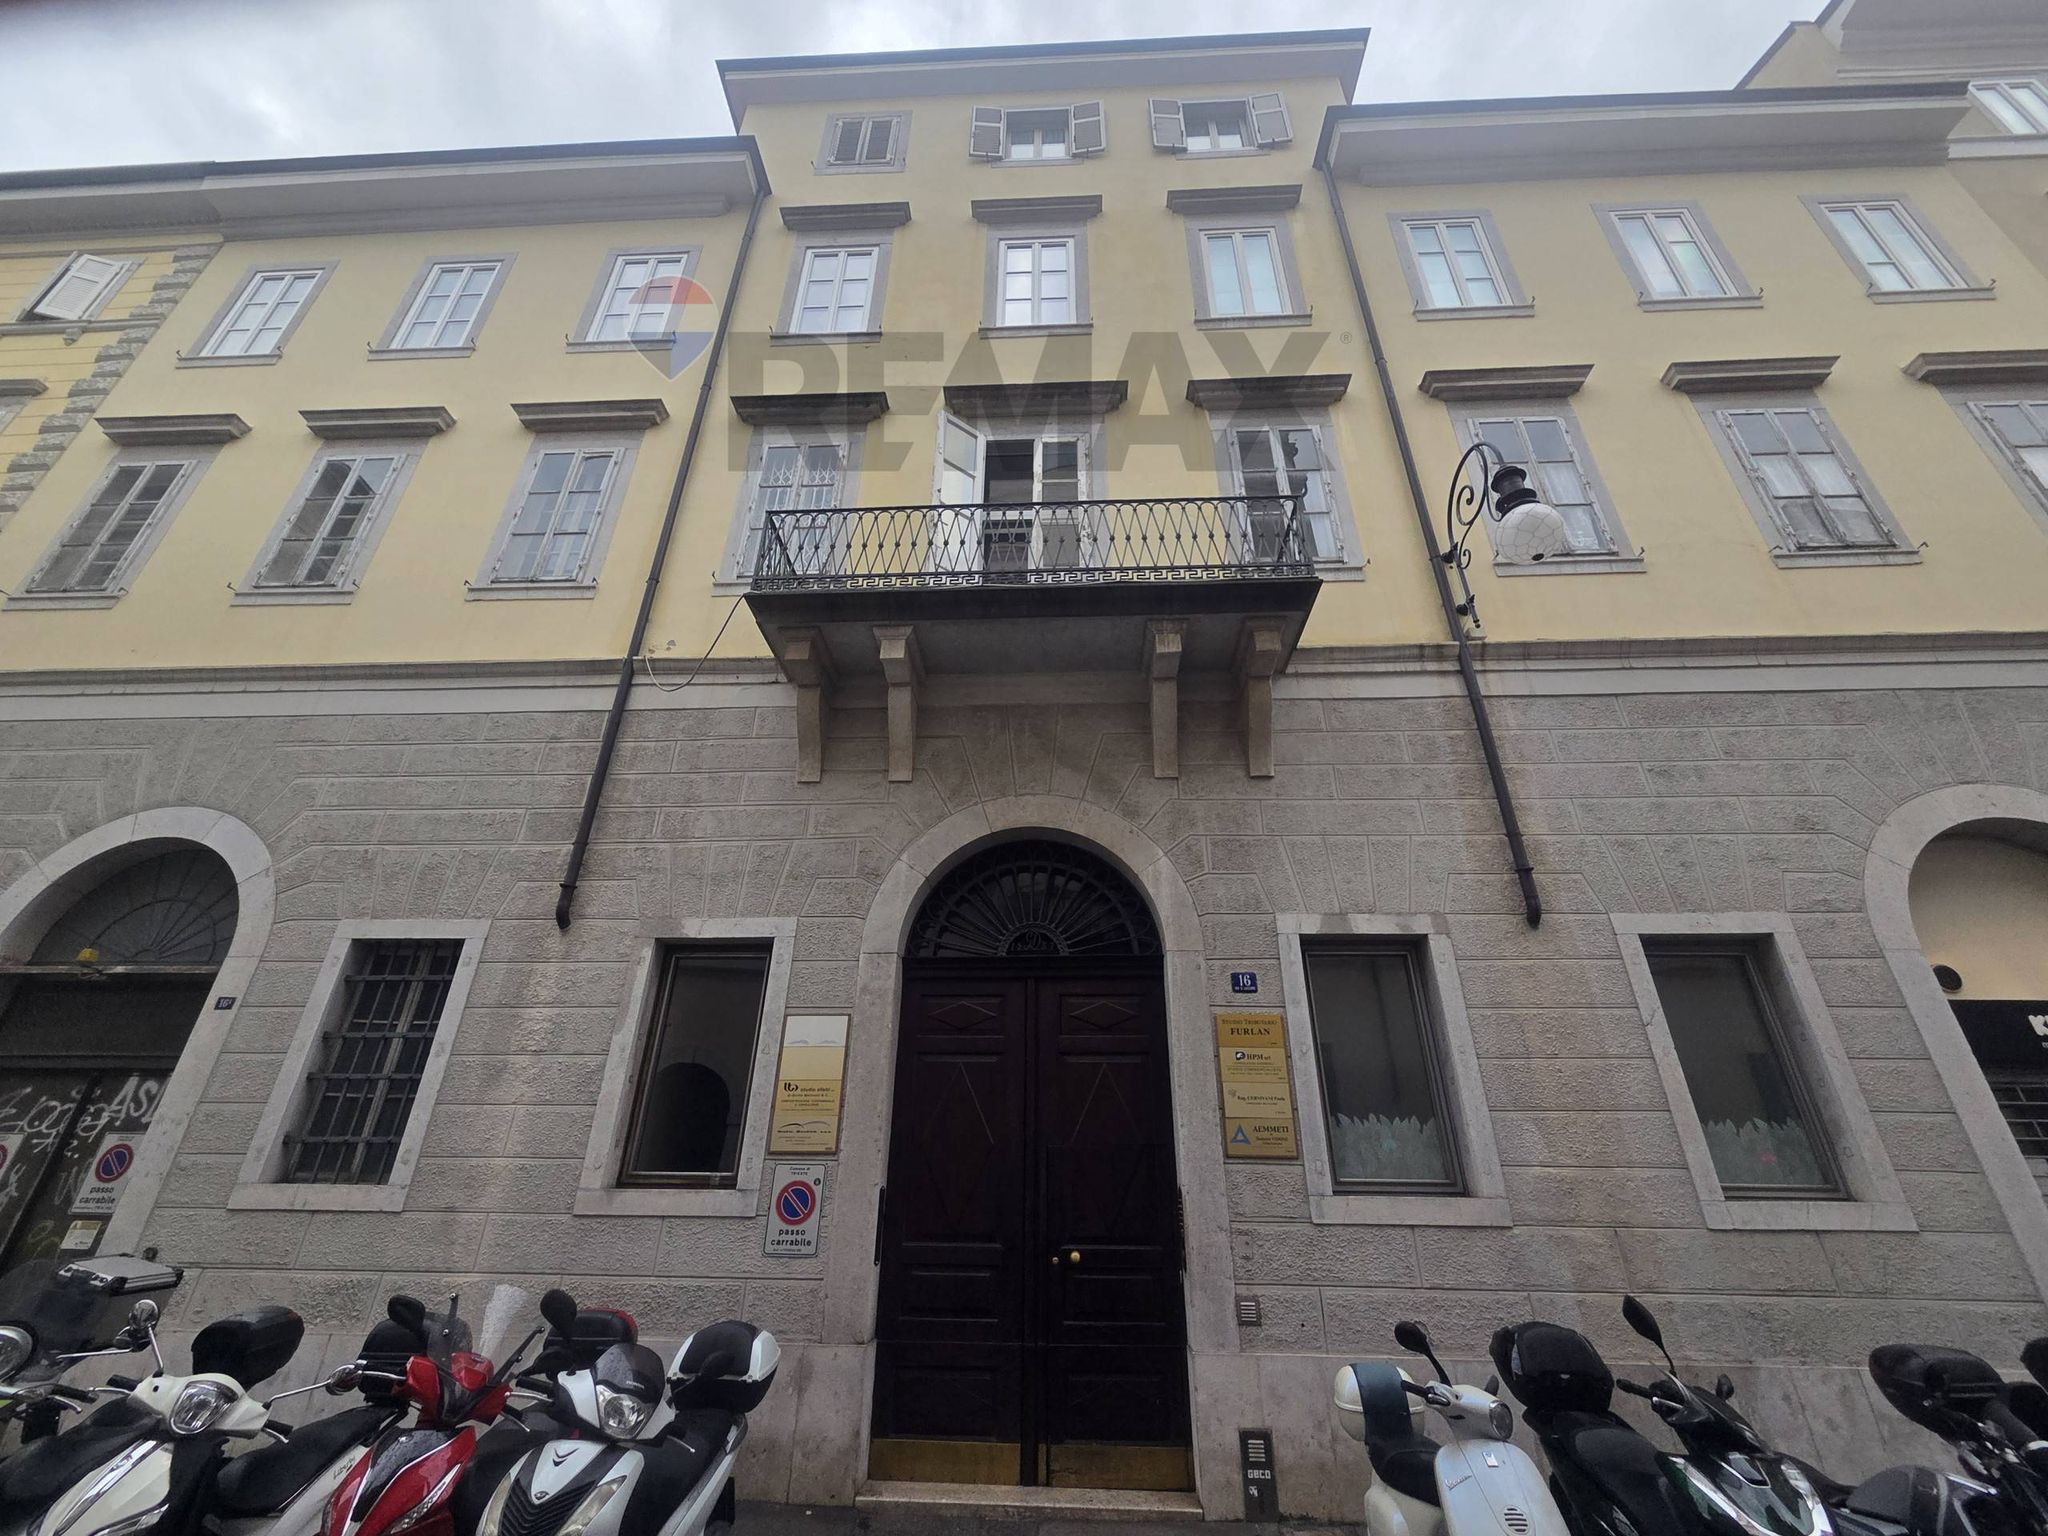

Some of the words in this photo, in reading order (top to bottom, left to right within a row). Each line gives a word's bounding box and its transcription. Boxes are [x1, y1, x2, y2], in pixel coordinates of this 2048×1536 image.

[1238, 974, 1251, 986] 16
[1230, 1027, 1270, 1036] FURLAN
[1246, 1053, 1263, 1061] HPM
[1253, 1125, 1289, 1133] AEMMETI
[90, 1186, 114, 1194] passo
[79, 1196, 116, 1204] carrabile
[770, 1237, 812, 1247] carrabile
